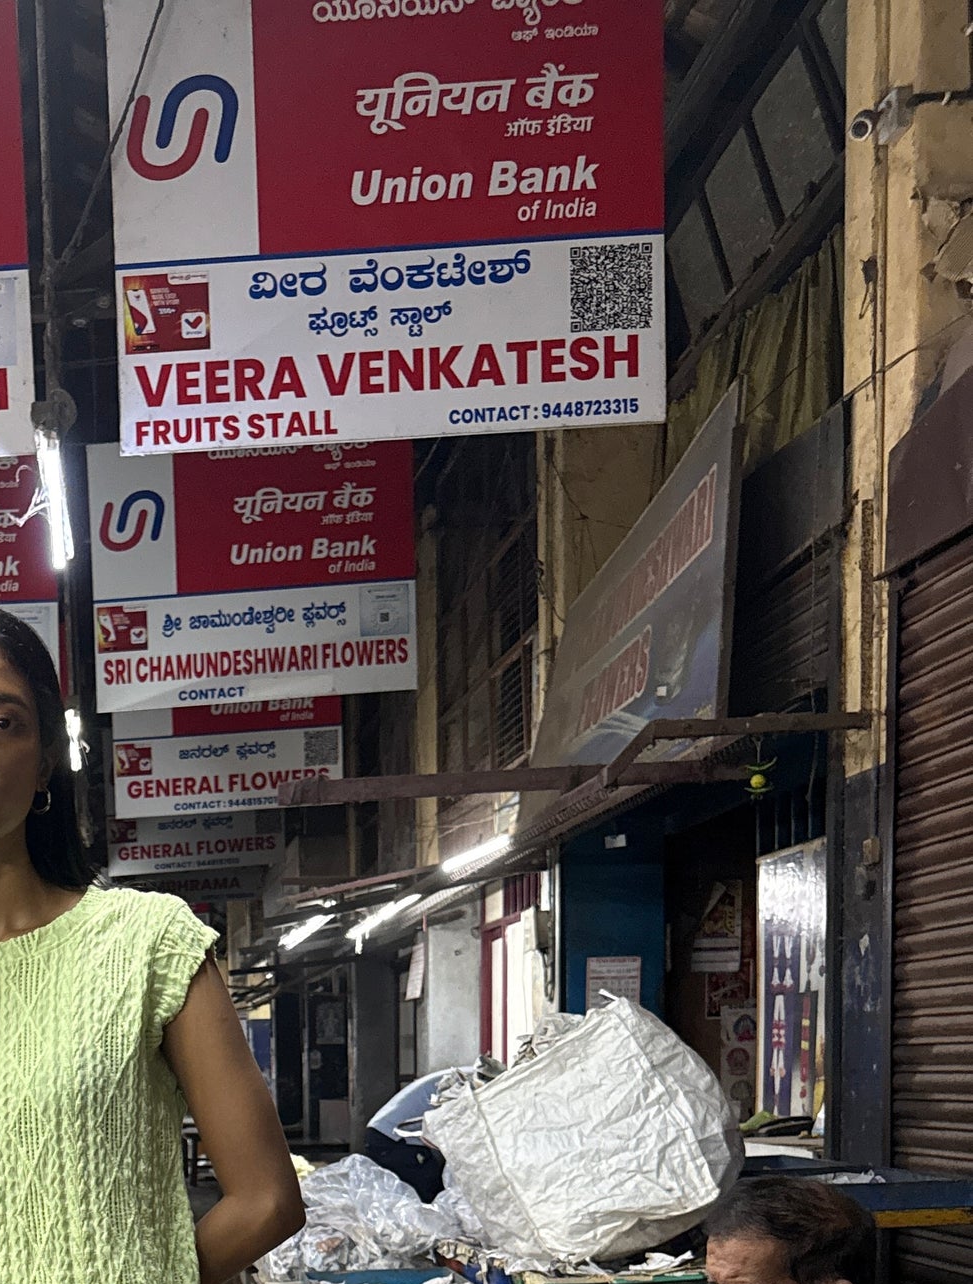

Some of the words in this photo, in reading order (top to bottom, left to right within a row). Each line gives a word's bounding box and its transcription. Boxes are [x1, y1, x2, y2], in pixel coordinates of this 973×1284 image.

[356, 72, 514, 135] यूनियन
[524, 63, 598, 109] बैंक
[504, 118, 541, 139] ऑफ
[544, 114, 594, 136] इंडिया
[350, 166, 472, 206] Union
[487, 156, 599, 197] Bank
[516, 199, 540, 223] of
[543, 196, 597, 220] India
[248, 262, 327, 300] ವೀರ
[349, 249, 531, 294] ವೆಂಕಟೇಶ್
[390, 301, 452, 337] ಸ್ಟಾಲ್
[135, 356, 308, 409] VEERA
[316, 333, 640, 397] VENKATESH
[135, 415, 241, 447] FRUITS
[246, 409, 338, 438] STALL
[233, 488, 327, 524] यूनियन
[333, 482, 376, 509] बैंक
[229, 541, 303, 565] Union
[311, 535, 376, 559] Bank
[328, 560, 342, 574] of
[344, 559, 376, 572] India
[104, 658, 131, 685] SRI
[136, 644, 318, 683] CHAMUNDESHWARI
[322, 637, 408, 666] FLOWERS
[178, 686, 245, 701] CONTACT
[268, 697, 314, 711] Bank
[291, 711, 314, 720] India
[127, 775, 223, 799] GENERAL
[118, 842, 193, 861] GENERAL
[196, 836, 276, 856] FLOWERS
